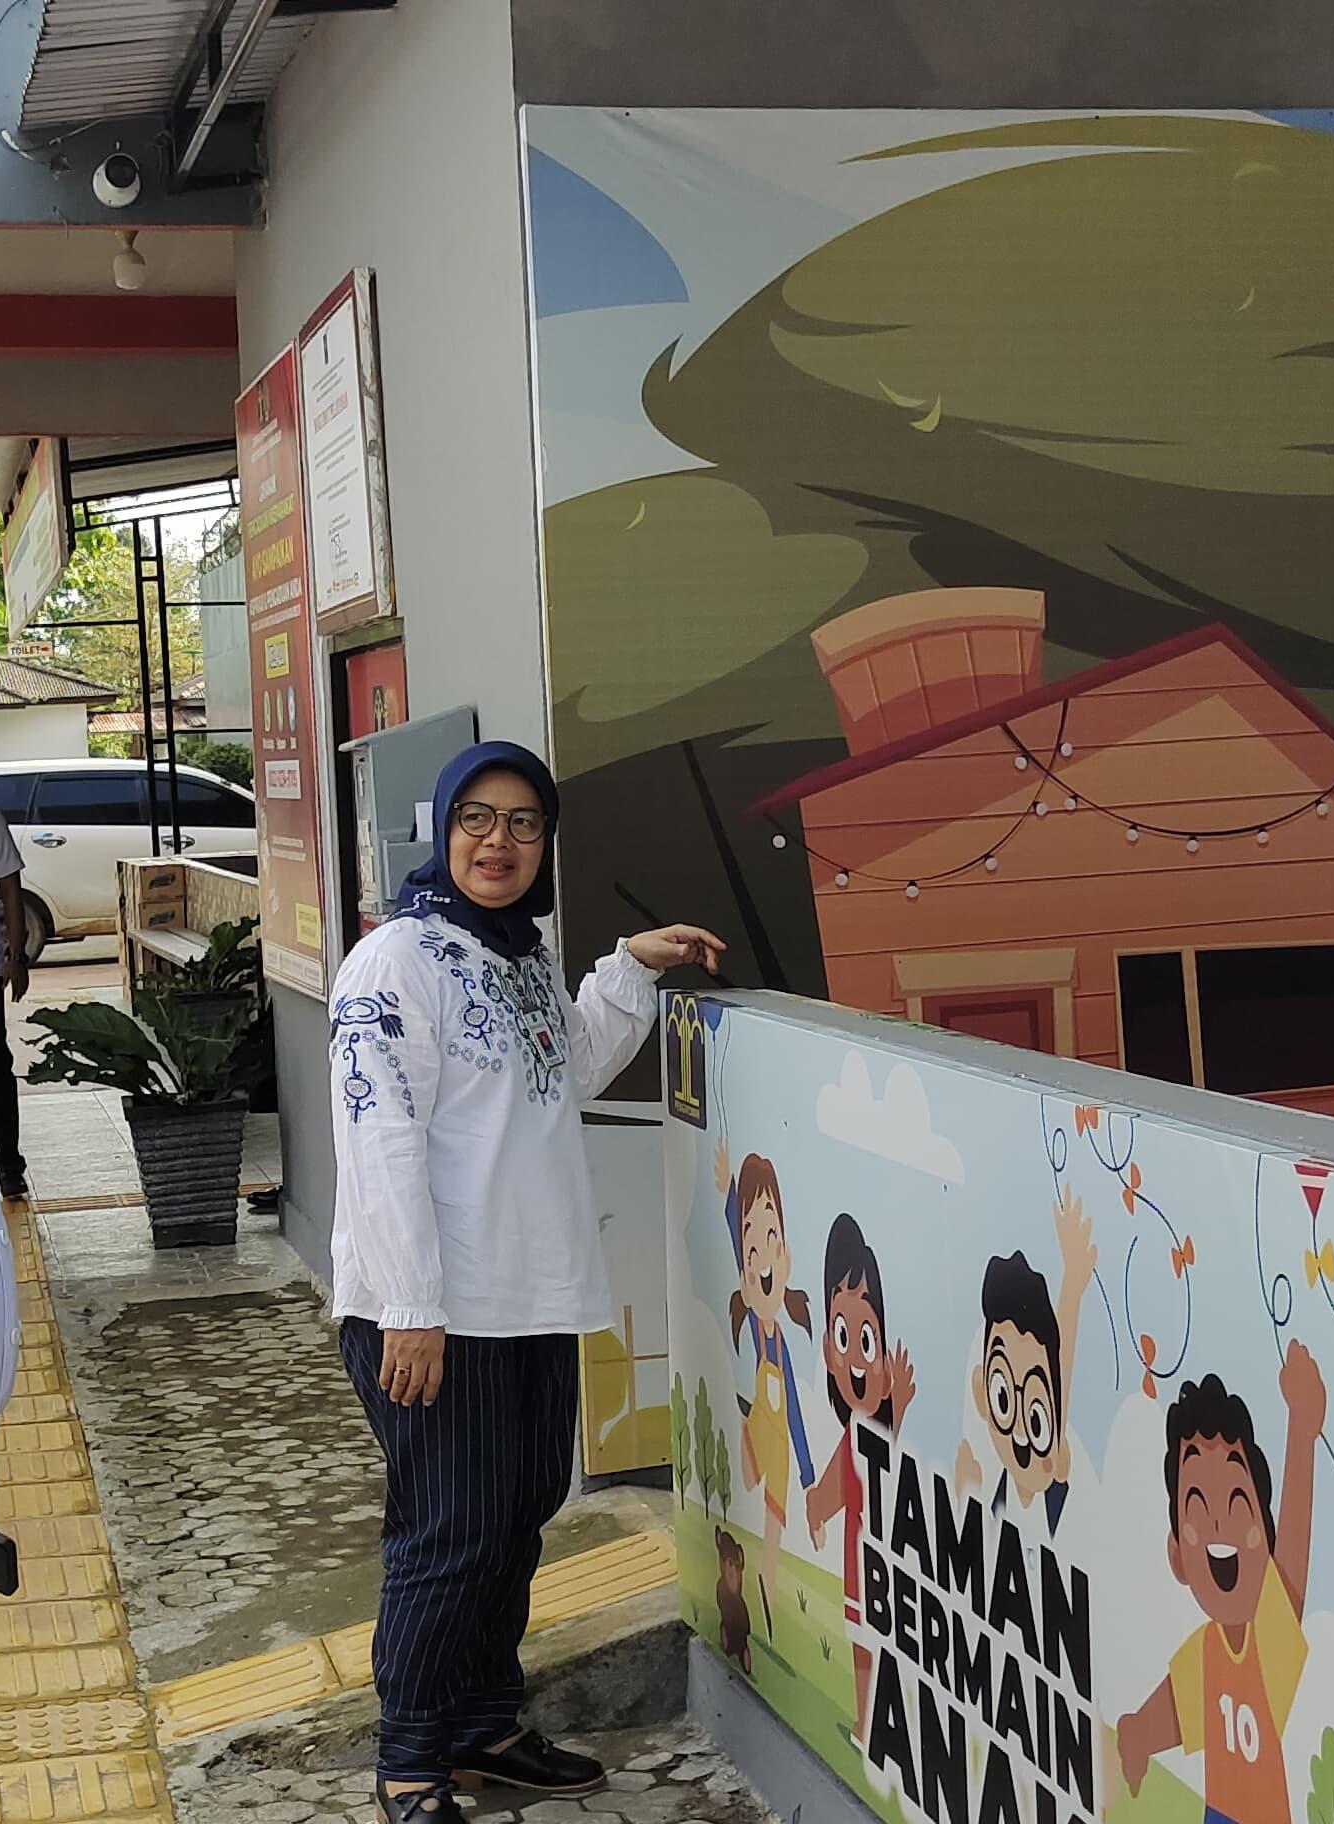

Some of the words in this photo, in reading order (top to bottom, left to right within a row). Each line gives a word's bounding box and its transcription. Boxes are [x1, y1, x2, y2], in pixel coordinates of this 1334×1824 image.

[10, 645, 40, 656] TOILET
[857, 1422, 1093, 1703] TAMAN
[863, 1541, 1095, 1816] BERMAIN
[1218, 1693, 1259, 1763] 10
